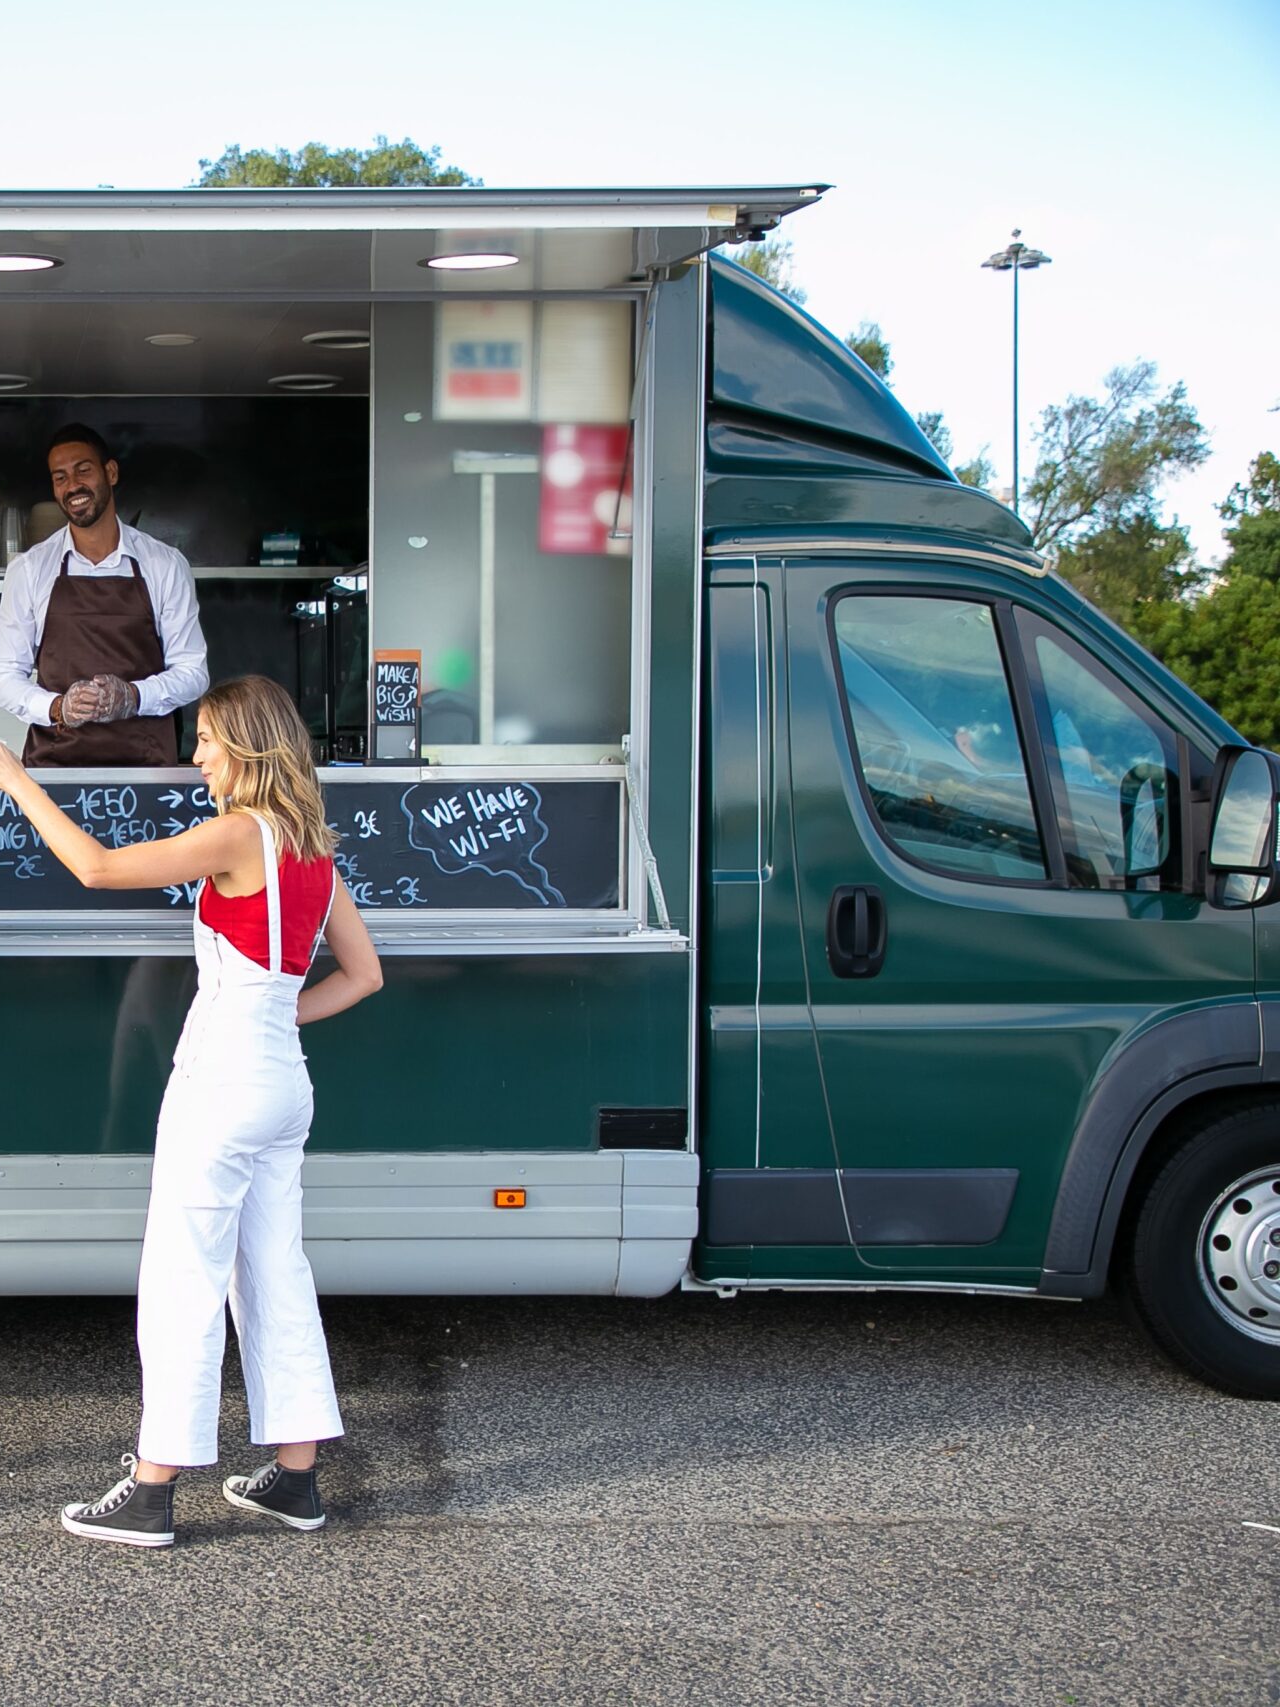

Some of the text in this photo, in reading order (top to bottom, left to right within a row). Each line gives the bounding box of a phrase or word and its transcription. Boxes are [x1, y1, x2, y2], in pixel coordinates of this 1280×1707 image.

[377, 664, 419, 684] MAKE A
[421, 785, 529, 829] WE HAVE
[354, 810, 382, 838] 3€
[396, 876, 428, 905] 3€
